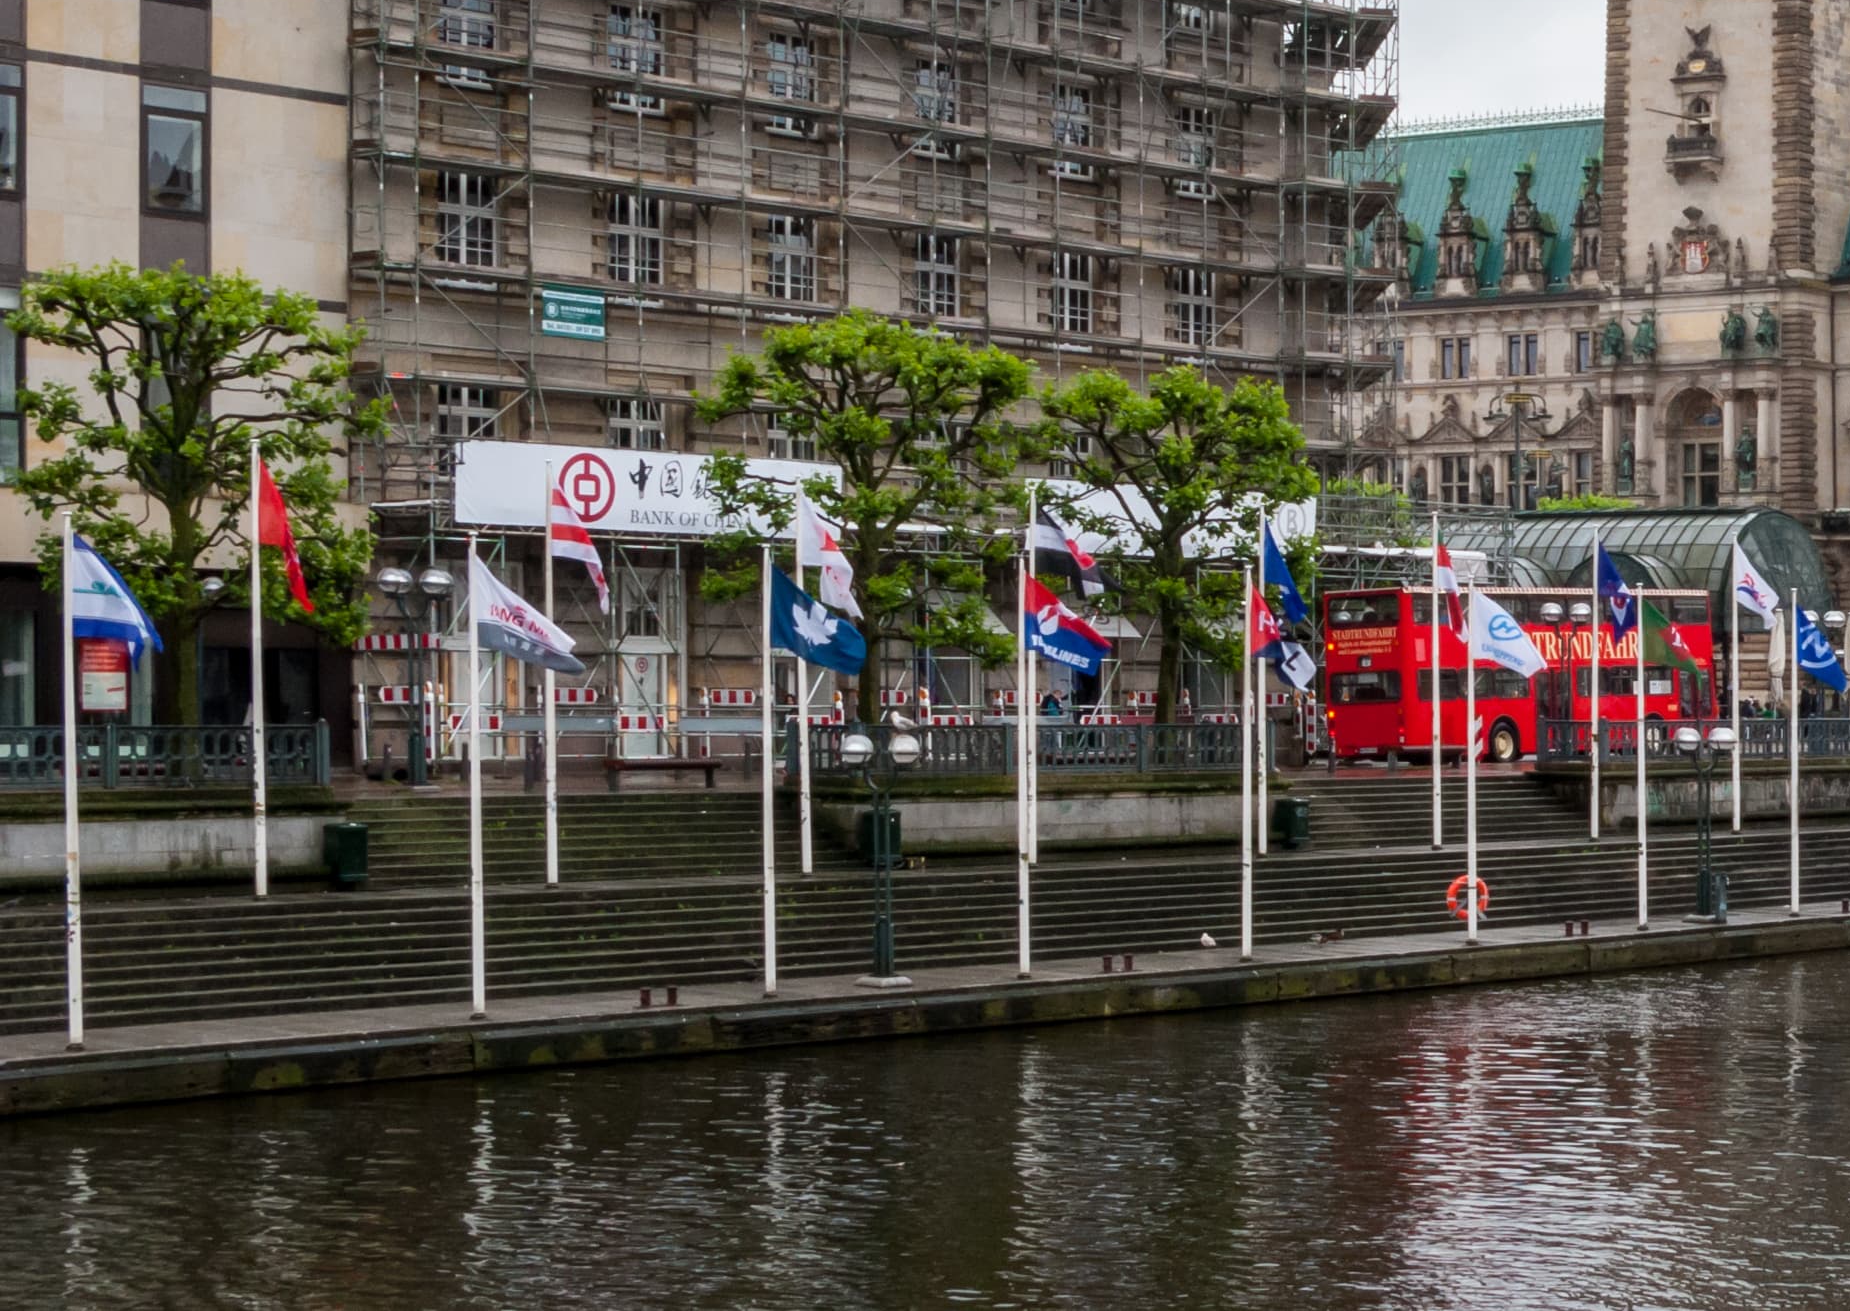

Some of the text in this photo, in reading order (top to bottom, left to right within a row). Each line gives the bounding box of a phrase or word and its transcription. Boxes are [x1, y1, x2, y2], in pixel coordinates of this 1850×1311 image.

[630, 509, 751, 530] BANK OF CHIN
